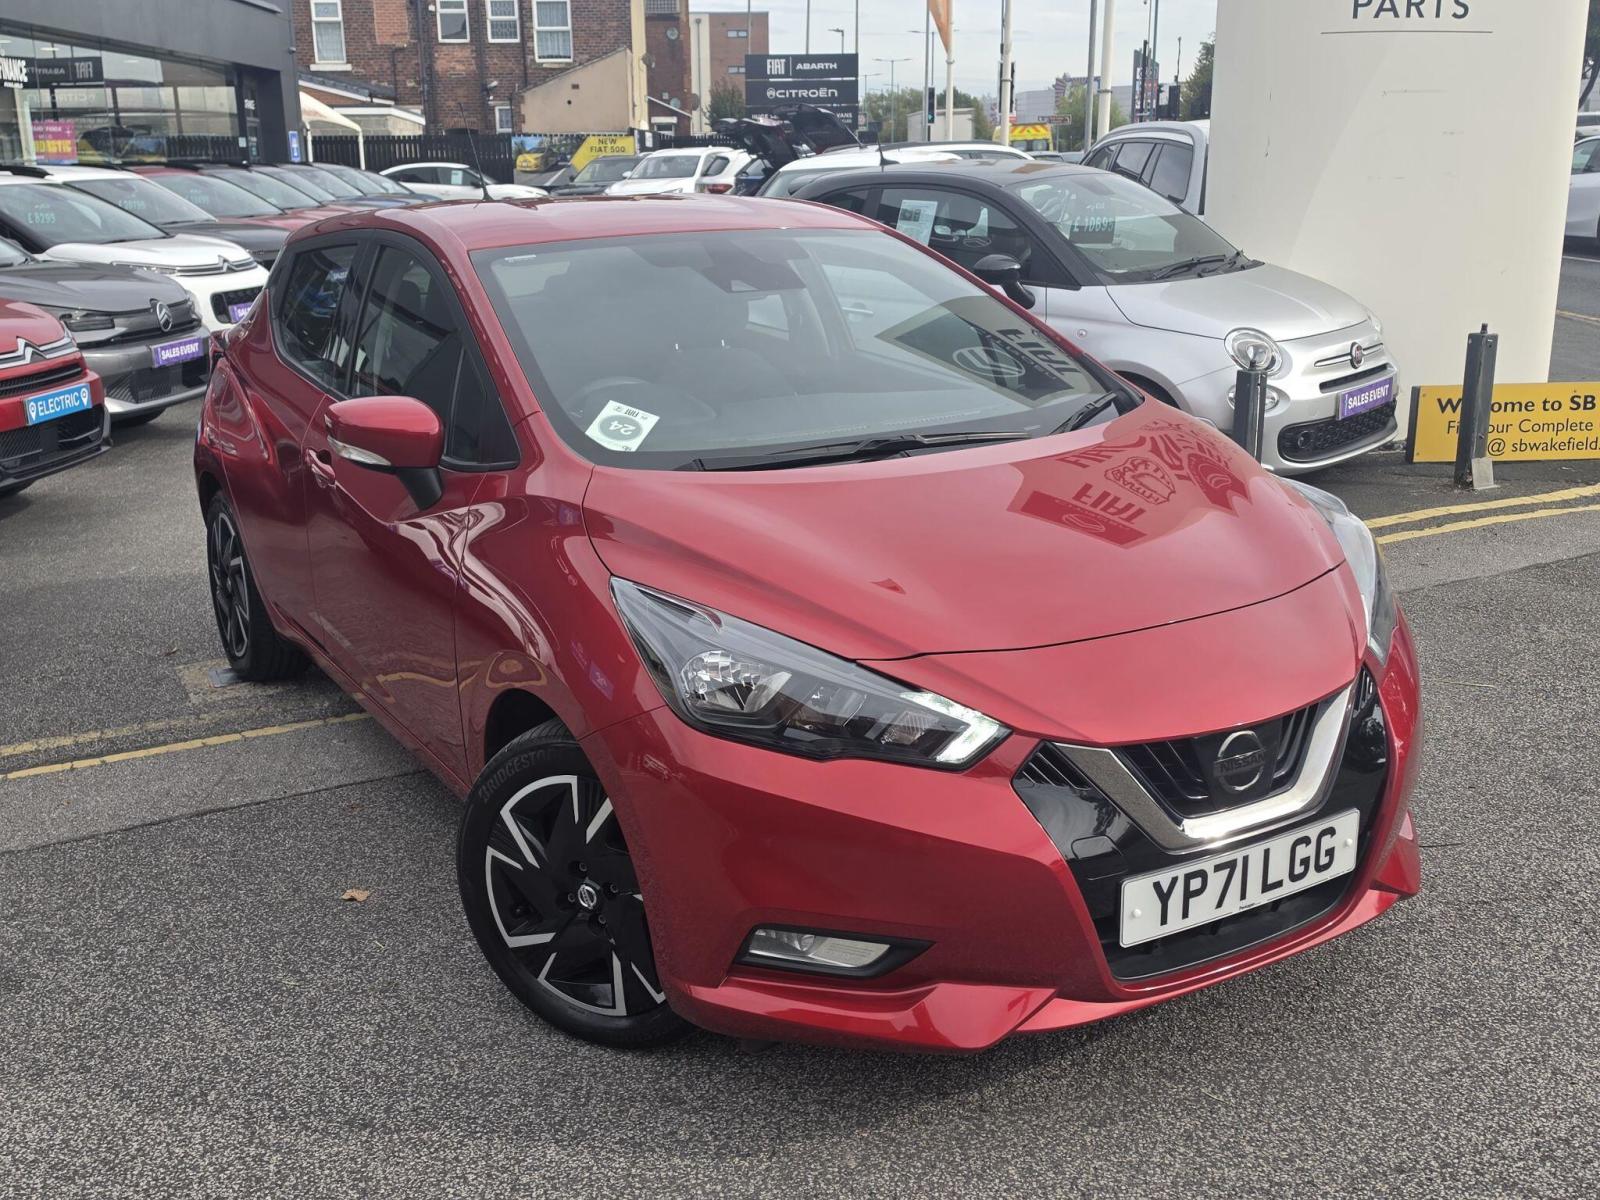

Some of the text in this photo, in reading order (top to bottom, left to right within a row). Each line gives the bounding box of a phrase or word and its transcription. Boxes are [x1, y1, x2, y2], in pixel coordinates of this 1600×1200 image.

[1352, 0, 1469, 19] PARTS
[767, 59, 837, 75] FIAT ABARTH
[776, 87, 838, 98] CITROËN
[161, 342, 199, 360] SALES EVENT
[38, 392, 80, 417] ELECTRIC
[1348, 392, 1369, 409] SALES
[1369, 384, 1390, 402] EVENT
[1437, 395, 1597, 414] Wome to SB
[609, 420, 636, 435] 24
[1488, 423, 1513, 434] our
[1519, 418, 1593, 436] Complete
[1488, 438, 1506, 456] @
[1220, 752, 1265, 773] NISSAN
[1152, 826, 1337, 927] YP71 LGG
